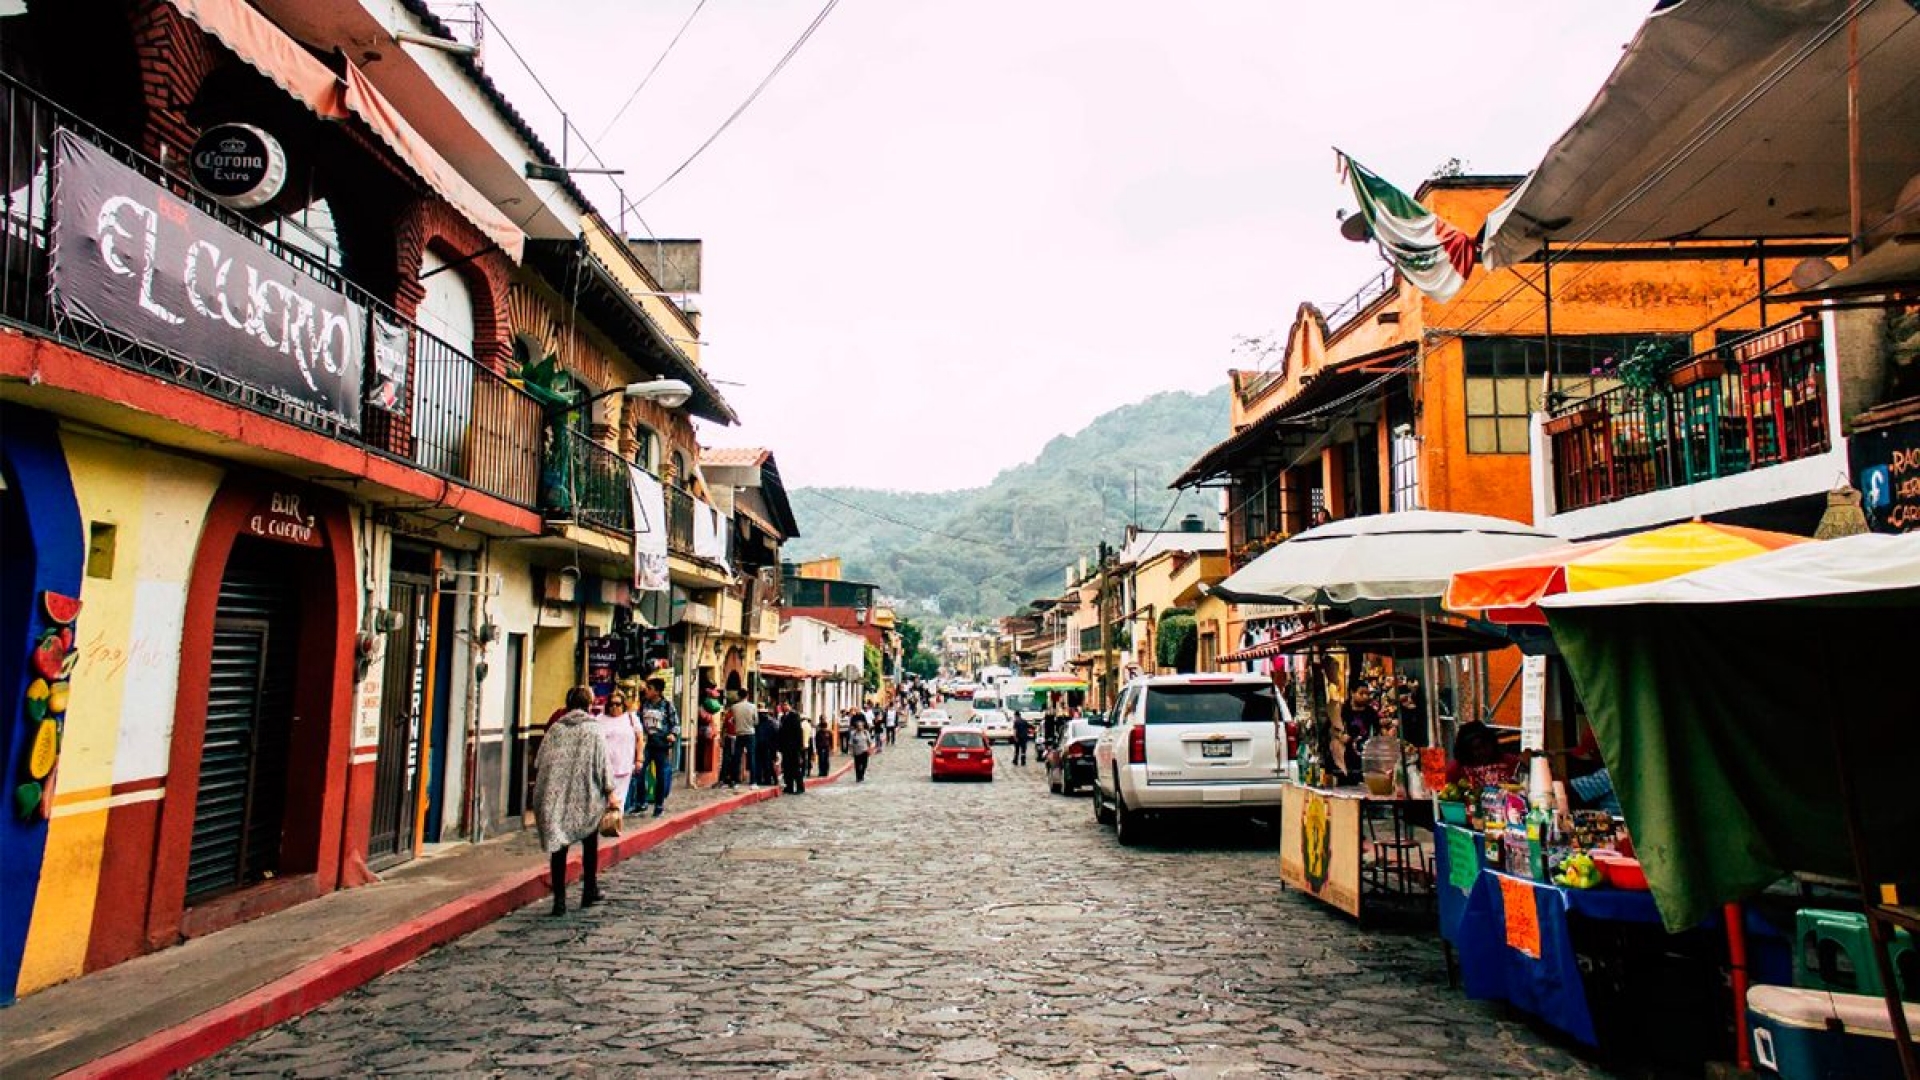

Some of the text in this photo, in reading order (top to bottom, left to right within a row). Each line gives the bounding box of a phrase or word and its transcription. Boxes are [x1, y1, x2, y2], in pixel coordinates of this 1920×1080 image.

[195, 151, 263, 169] Corona
[214, 167, 250, 181] Extra
[98, 196, 351, 391] EL CUERVO
[271, 492, 303, 523] BAR
[251, 515, 312, 543] EL CUERVO
[407, 594, 426, 791] INTERNET
